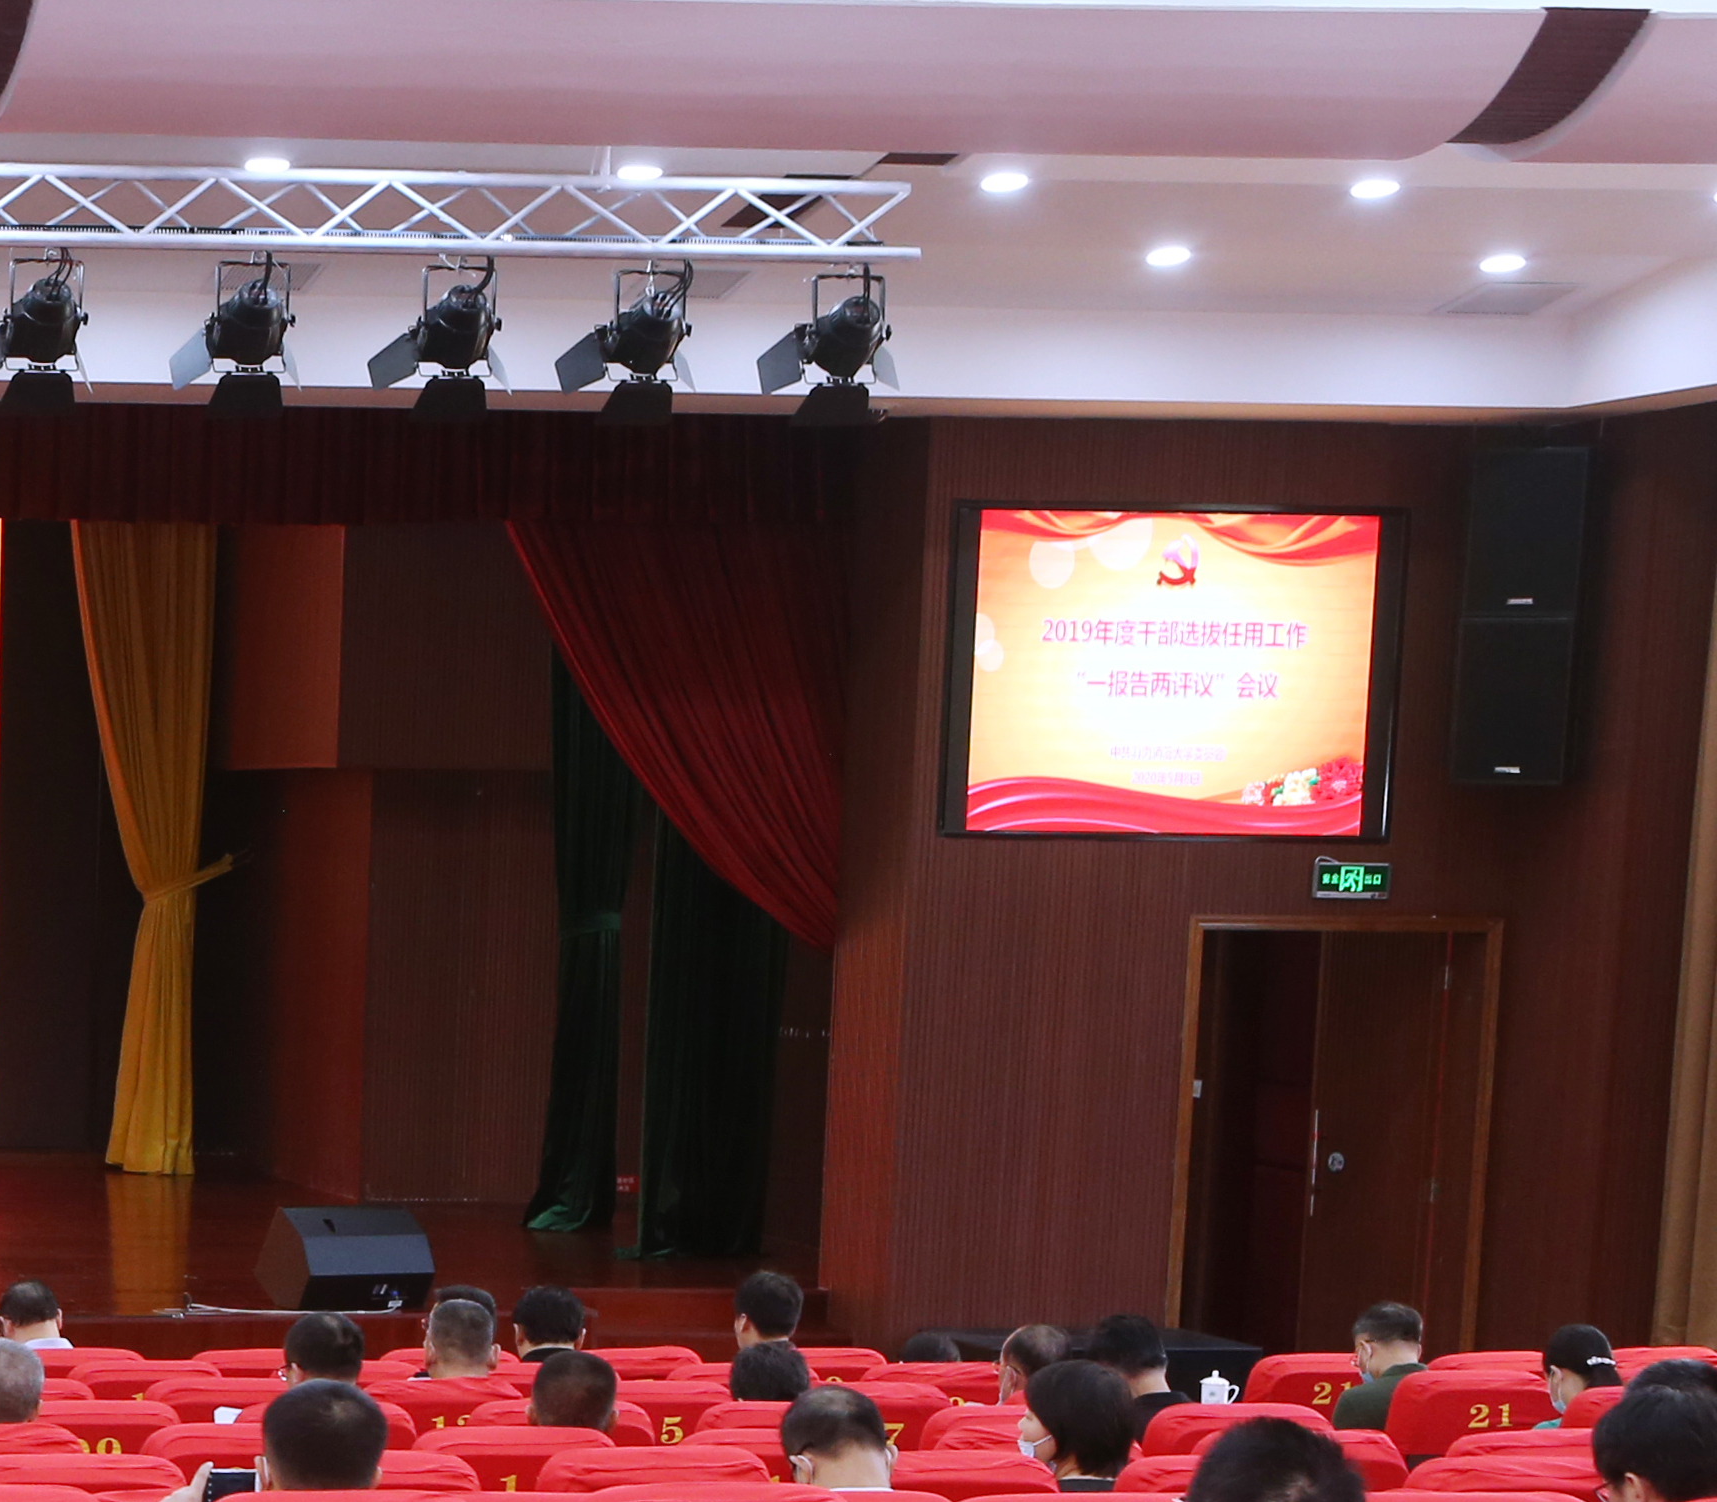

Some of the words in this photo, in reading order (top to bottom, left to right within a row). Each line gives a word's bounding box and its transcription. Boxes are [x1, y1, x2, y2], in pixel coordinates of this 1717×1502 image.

[1041, 618, 1308, 648] 2019年度干部选拔任用工作
[1468, 1402, 1513, 1429] 21
